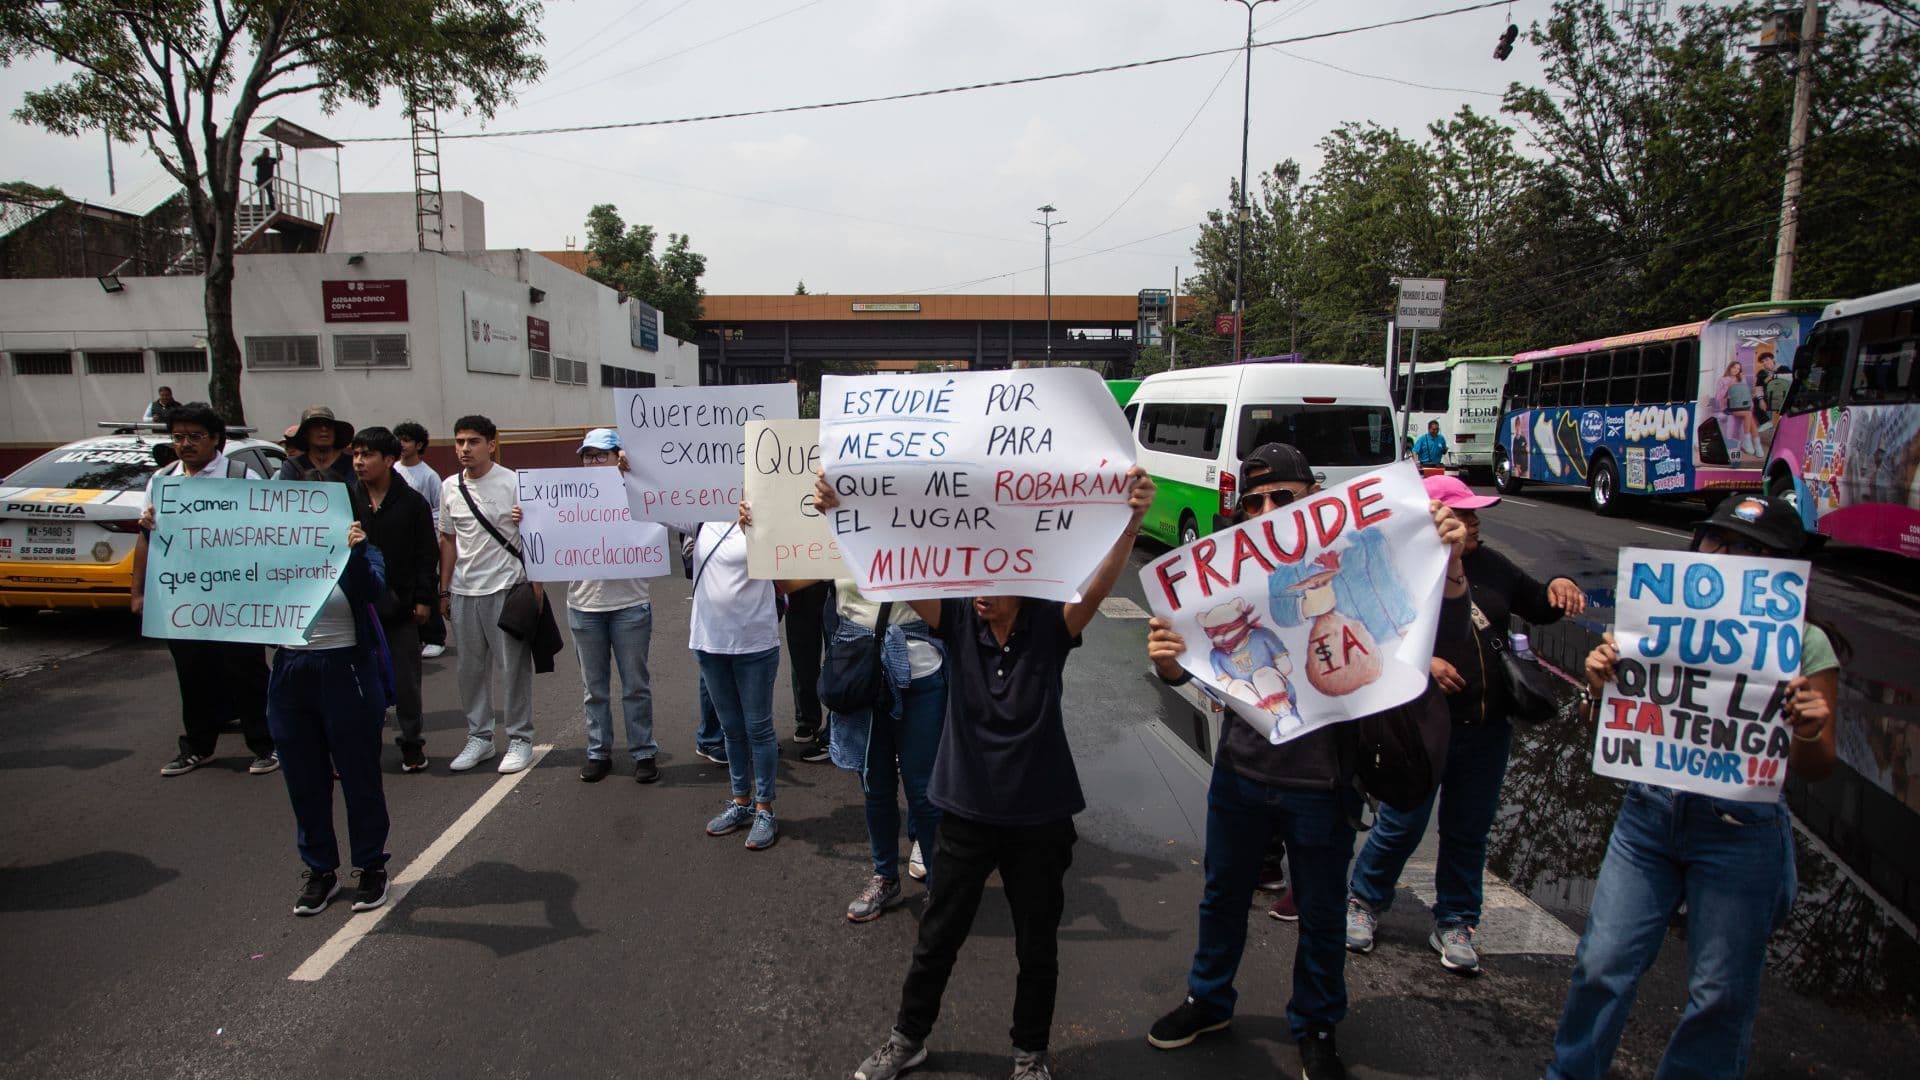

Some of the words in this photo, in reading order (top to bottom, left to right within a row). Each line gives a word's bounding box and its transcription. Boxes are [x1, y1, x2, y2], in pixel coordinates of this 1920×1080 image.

[363, 295, 385, 303] CÍVICO
[1737, 328, 1780, 337] Reebok
[844, 379, 955, 415] ESTUDIÉ
[985, 383, 1040, 416] POR
[1459, 387, 1498, 395] TLALPAN
[630, 394, 766, 429] Queremos
[1459, 407, 1493, 417] PEDR
[1625, 406, 1689, 442] ESCOLAR
[839, 431, 950, 460] MESES
[987, 425, 1053, 456] PARA
[518, 471, 599, 508] Exigimos
[836, 474, 899, 497] QUE
[924, 471, 970, 498] ME
[995, 459, 1129, 502] ROBARÁN
[7, 503, 86, 514] POLICÍA
[160, 484, 239, 515] Examen
[249, 487, 330, 514] LIMPIO
[836, 509, 871, 536] EL
[891, 506, 996, 531] LUGAR
[1035, 509, 1074, 532] EN
[182, 526, 336, 554] TRANSPARENTE,
[520, 532, 545, 565] NO
[554, 537, 663, 566] cancelaciones
[1155, 477, 1393, 611] FRAUDE
[159, 570, 197, 595] que
[200, 568, 241, 592] gane
[245, 562, 258, 582] el
[265, 559, 338, 585] aspirante
[869, 546, 1034, 583] MINUTOS
[1629, 563, 1724, 610] NO
[1740, 569, 1804, 621] ES
[172, 603, 311, 630] CONSCIENTE
[1638, 616, 1802, 673] JUSTO
[1615, 658, 1711, 713] QUE
[1605, 697, 1665, 736] IA
[1670, 709, 1791, 759] TENGA
[1602, 736, 1643, 767] UN
